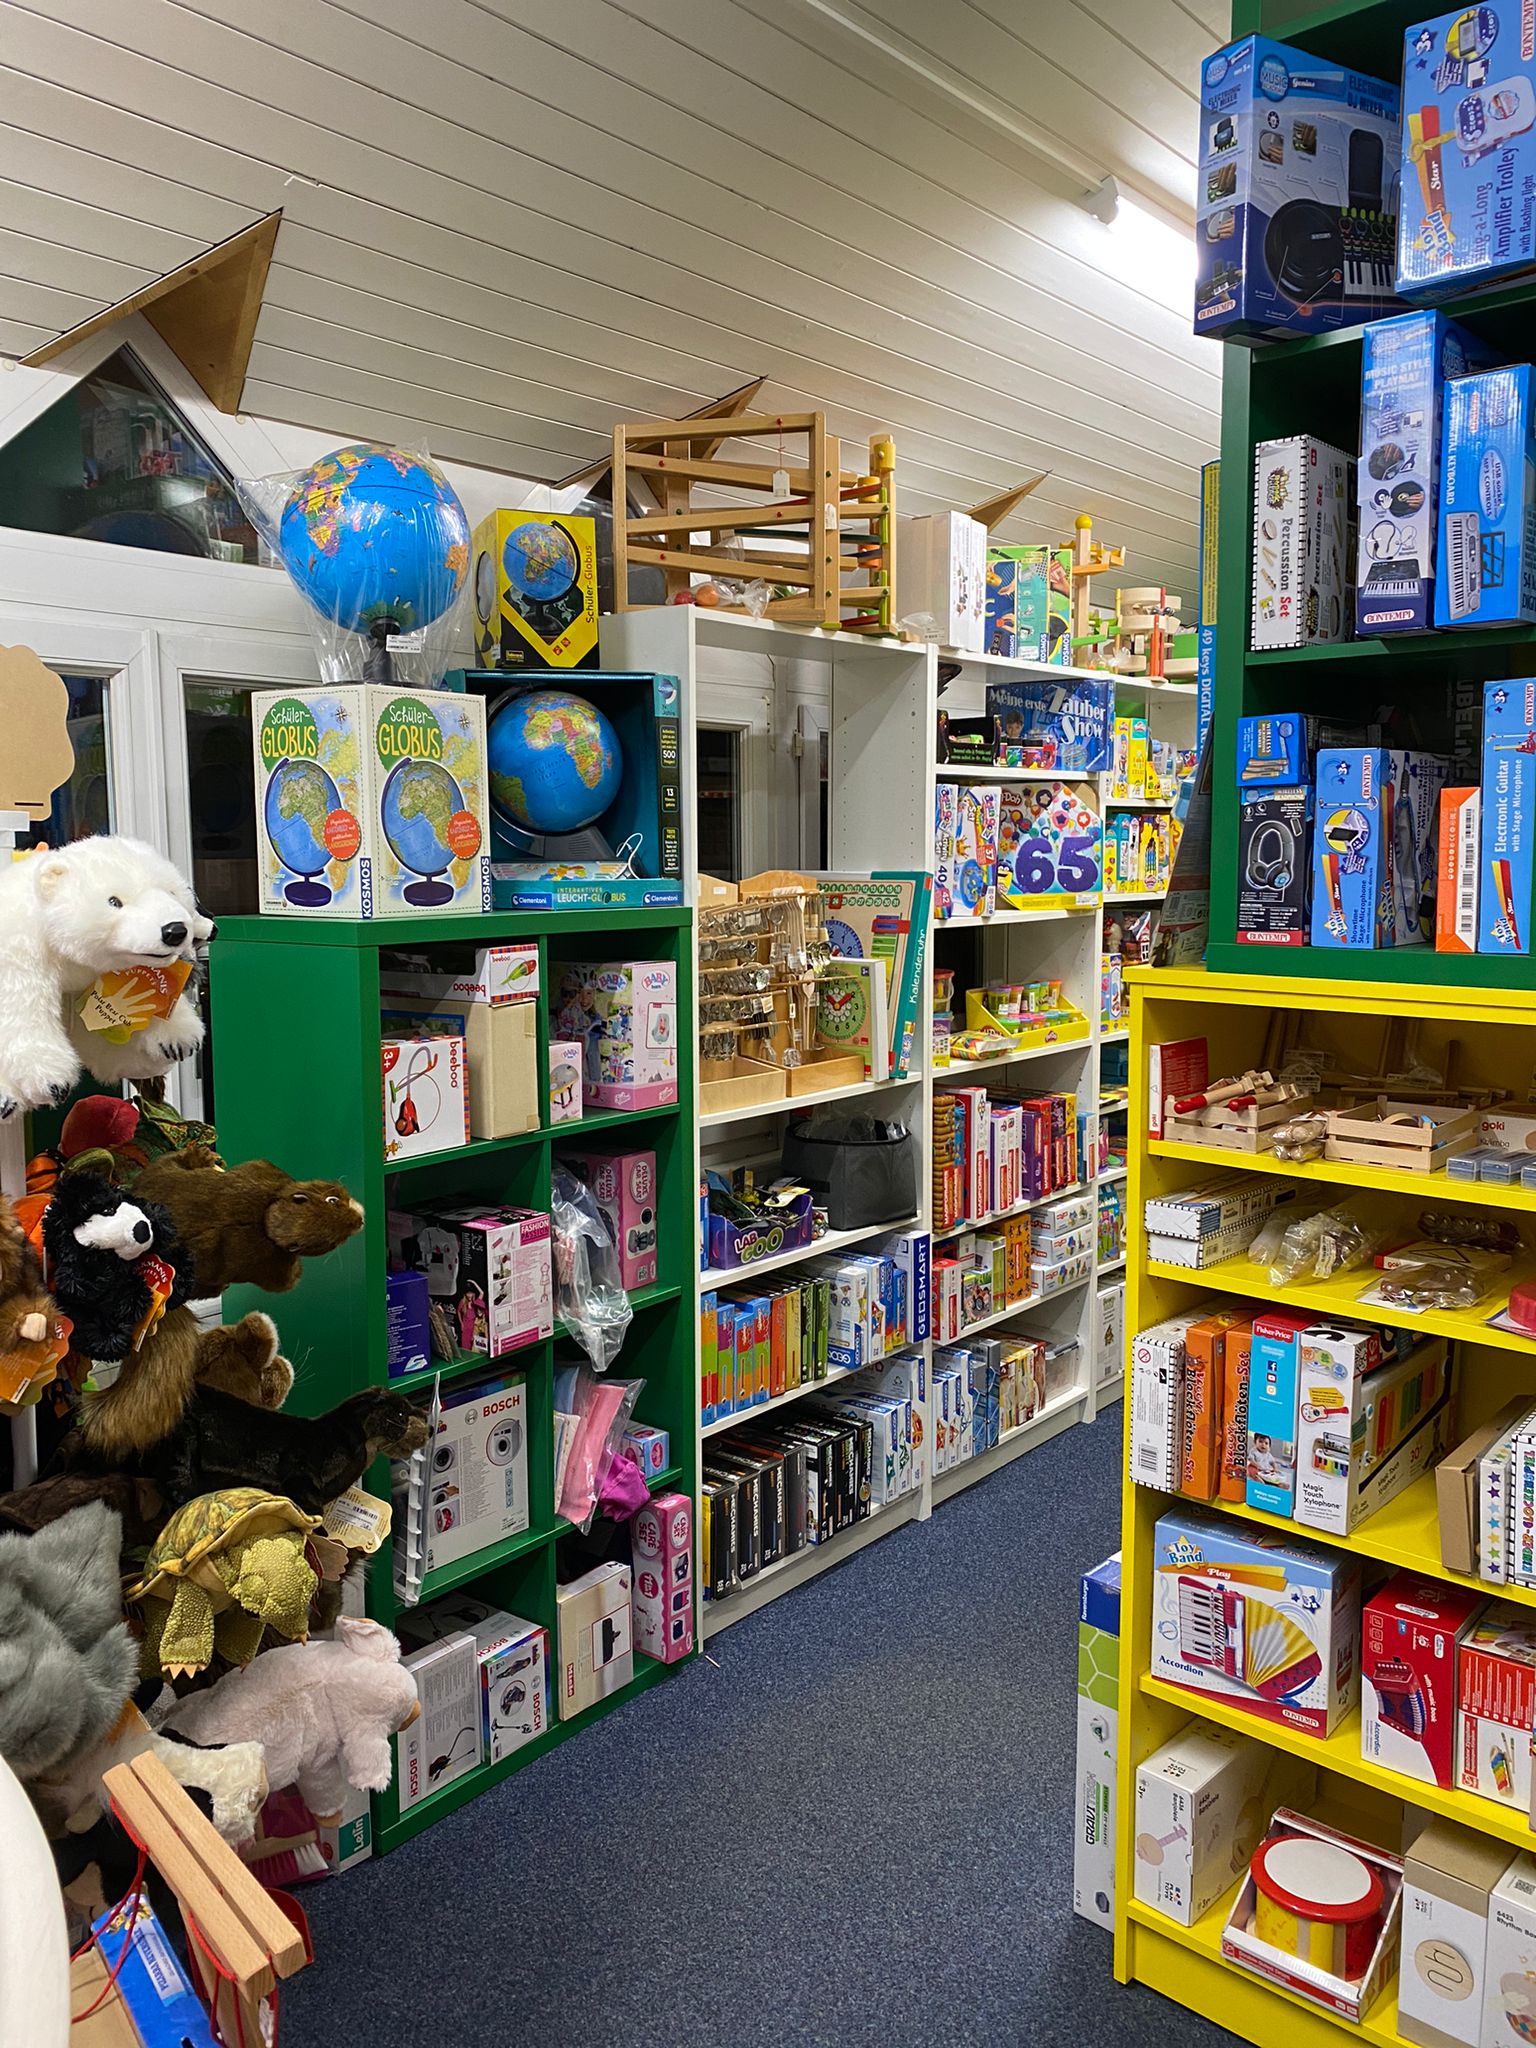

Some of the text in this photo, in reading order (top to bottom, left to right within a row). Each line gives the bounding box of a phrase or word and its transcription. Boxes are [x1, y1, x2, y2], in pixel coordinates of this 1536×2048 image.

[1261, 71, 1288, 88] MUSIC
[1292, 78, 1315, 88] Genius
[1431, 161, 1441, 190] Star
[1493, 147, 1519, 257] Amplifier Trolley
[1520, 175, 1536, 254] with flashing light
[1401, 358, 1431, 372] STYLE
[1446, 455, 1457, 505] KEYBOARD
[1483, 477, 1492, 516] CONTROLS
[1313, 511, 1322, 585] Percussion
[1280, 518, 1293, 618] Percussion Set
[586, 545, 596, 624] Schüler-Globus
[1366, 611, 1411, 623] BONTEMPI
[1201, 629, 1212, 644] 49
[1200, 648, 1212, 675] keys
[389, 705, 433, 724] Schüler-
[990, 685, 1106, 720] Meine erste Zauber
[1201, 679, 1213, 724] DIGITAL
[270, 707, 310, 725] Schüler-
[262, 725, 318, 758] GLOBUS
[379, 723, 441, 758] GLOBUS
[1061, 715, 1104, 745] Show
[663, 751, 676, 760] 500
[1363, 756, 1372, 796] BONTEMPI
[667, 788, 674, 797] 13
[1494, 760, 1510, 853] Electronic Guitar
[1512, 759, 1524, 853] with Stage Microphone
[938, 866, 948, 883] 40
[1015, 837, 1098, 893] 65
[361, 859, 371, 917] KOSMOS
[482, 858, 490, 912] KOSMOS
[942, 891, 950, 904] 42
[518, 897, 547, 905] Clementoni
[651, 894, 678, 903] Clementoni
[1249, 932, 1288, 942] BONTEMPI
[1351, 909, 1359, 943] Showtime
[1499, 917, 1514, 943] Band
[126, 970, 158, 986] PUPPETS
[909, 929, 926, 1003] Kalenderuhr
[453, 983, 486, 996] beeboo
[599, 971, 627, 989] BABY
[643, 971, 670, 988] BABY
[90, 990, 132, 1027] Polar Bear Cub
[95, 1004, 116, 1025] Puppet
[383, 1051, 394, 1069] 3+
[450, 1041, 460, 1088] beeboo
[1482, 1120, 1505, 1132] goki
[604, 1167, 613, 1199] DELUXE
[635, 1180, 643, 1201] SEAT
[642, 1161, 650, 1197] DELUXE
[520, 1219, 549, 1235] FASHION
[735, 1233, 757, 1254] LAB
[741, 1227, 784, 1264] GOO
[918, 1243, 927, 1336] GEOSMART
[1256, 1326, 1292, 1341] Fisher-Price
[483, 1395, 521, 1418] BOSCH
[1234, 1351, 1250, 1469] Blockflöten-Set
[1183, 1366, 1198, 1483] Blockflöten-Set
[1303, 1483, 1324, 1494] Magic
[1304, 1490, 1324, 1499] Touch
[1304, 1498, 1340, 1510] Xylophone
[1522, 1450, 1536, 1573] KINDER-GLOCKENSPIEL
[639, 1522, 647, 1544] SET
[647, 1522, 657, 1549] CARE
[680, 1517, 688, 1538] CARE
[1169, 1551, 1203, 1564] Band
[1173, 1542, 1196, 1555] Toy
[1207, 1568, 1231, 1580] Play
[1081, 1578, 1089, 1621] Ravensburger
[477, 1637, 508, 1658] BOSCH
[1159, 1655, 1204, 1678] Accordion
[567, 1665, 575, 1697] Miele
[1423, 1673, 1431, 1688] with
[1427, 1690, 1436, 1706] music
[533, 1691, 541, 1731] BOSCH
[1285, 1710, 1318, 1727] BONTEMPI
[1372, 1721, 1381, 1756] Accordion
[410, 1758, 418, 1797] BOSCH
[1496, 1910, 1514, 1923] 6423
[1496, 1917, 1523, 1935] Rhythm
[150, 1962, 169, 1992] PIZARRA
